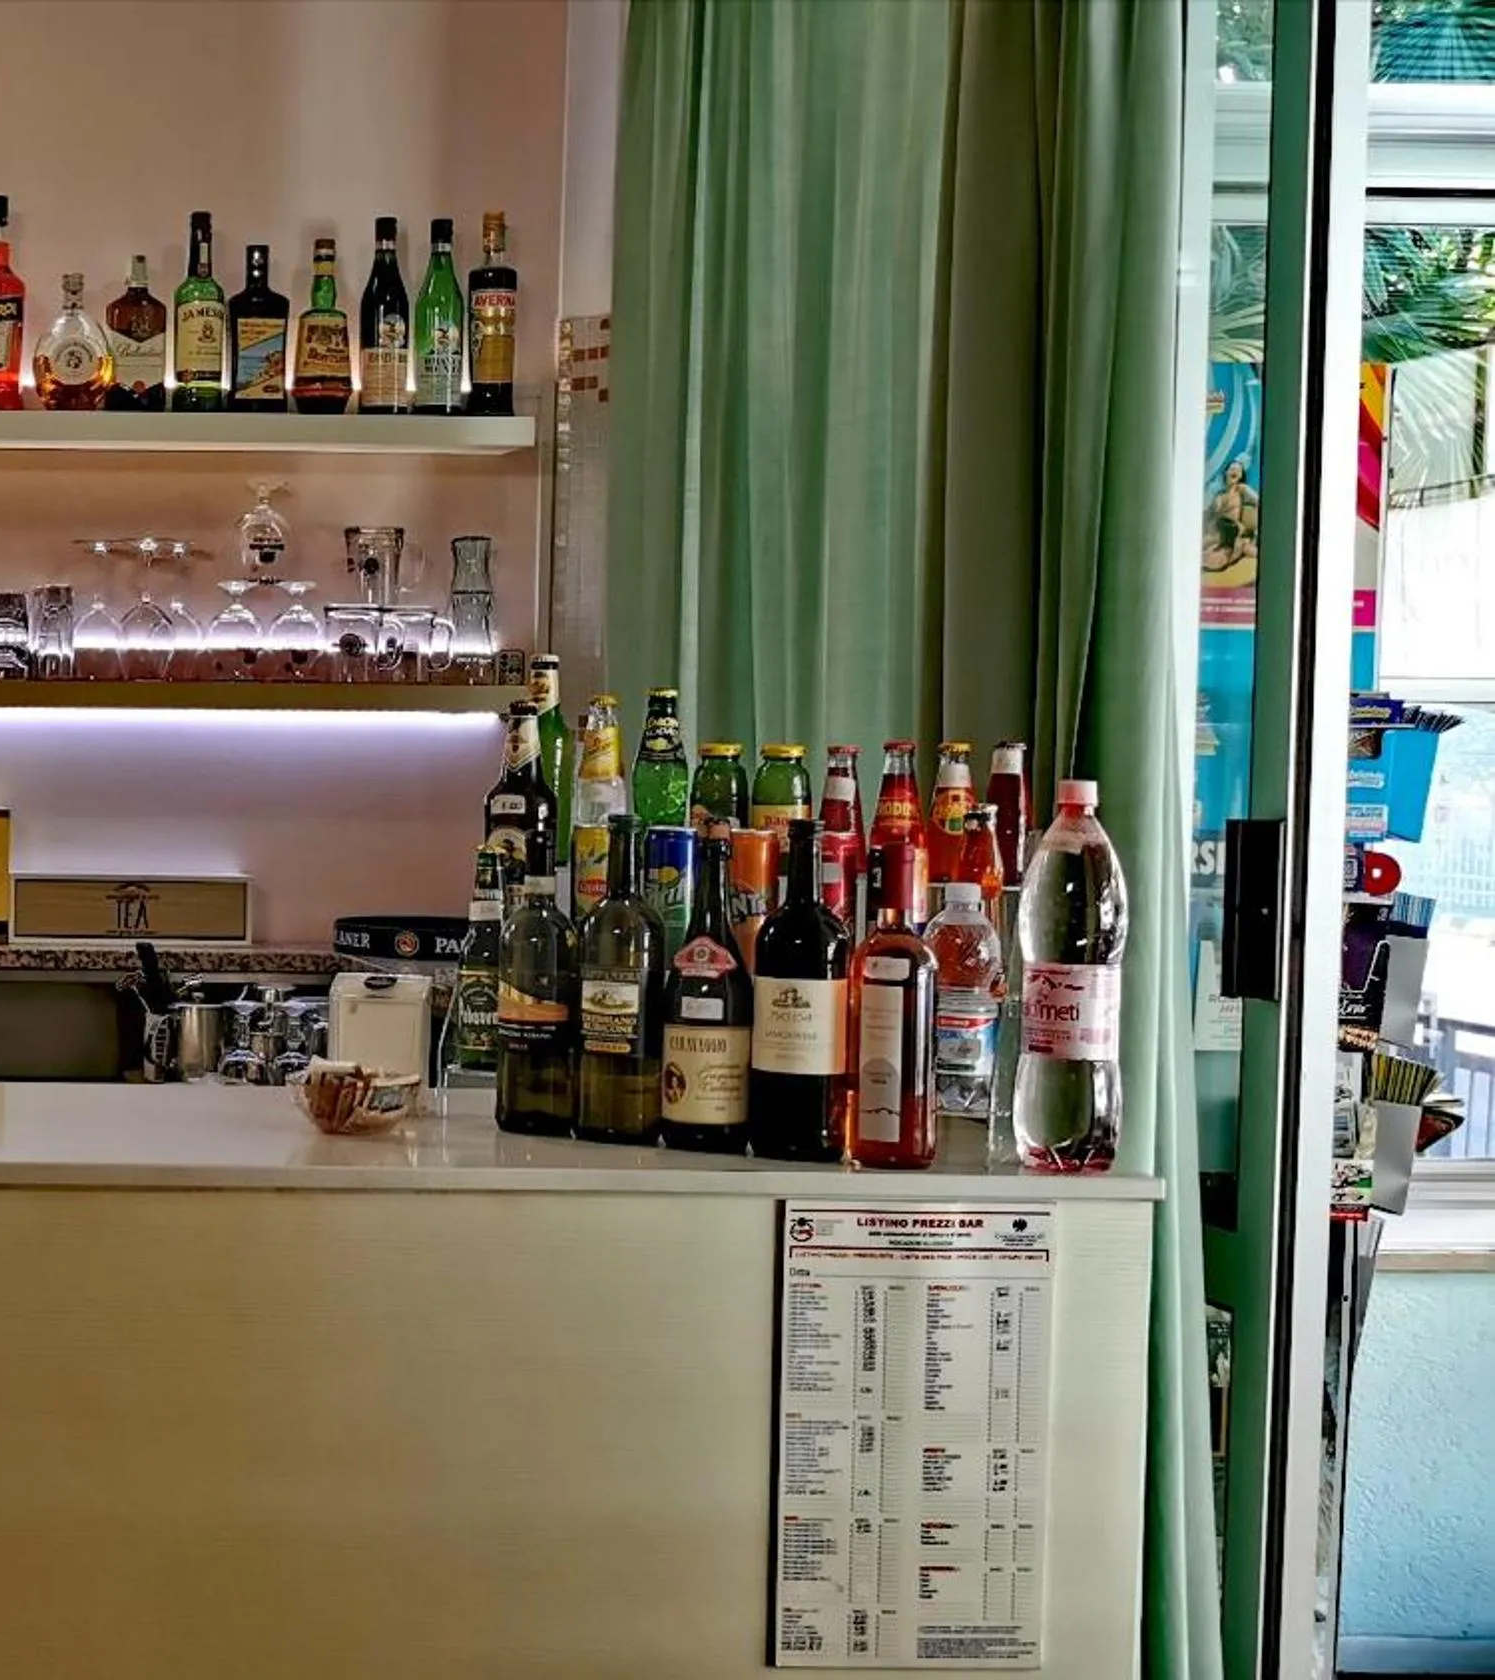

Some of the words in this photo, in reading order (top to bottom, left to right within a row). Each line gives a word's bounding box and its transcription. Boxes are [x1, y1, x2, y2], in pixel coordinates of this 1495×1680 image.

[116, 900, 149, 930] TEA
[856, 1217, 909, 1229] LISTINO
[911, 1218, 956, 1230] PREZZI
[958, 1218, 985, 1230] BAR
